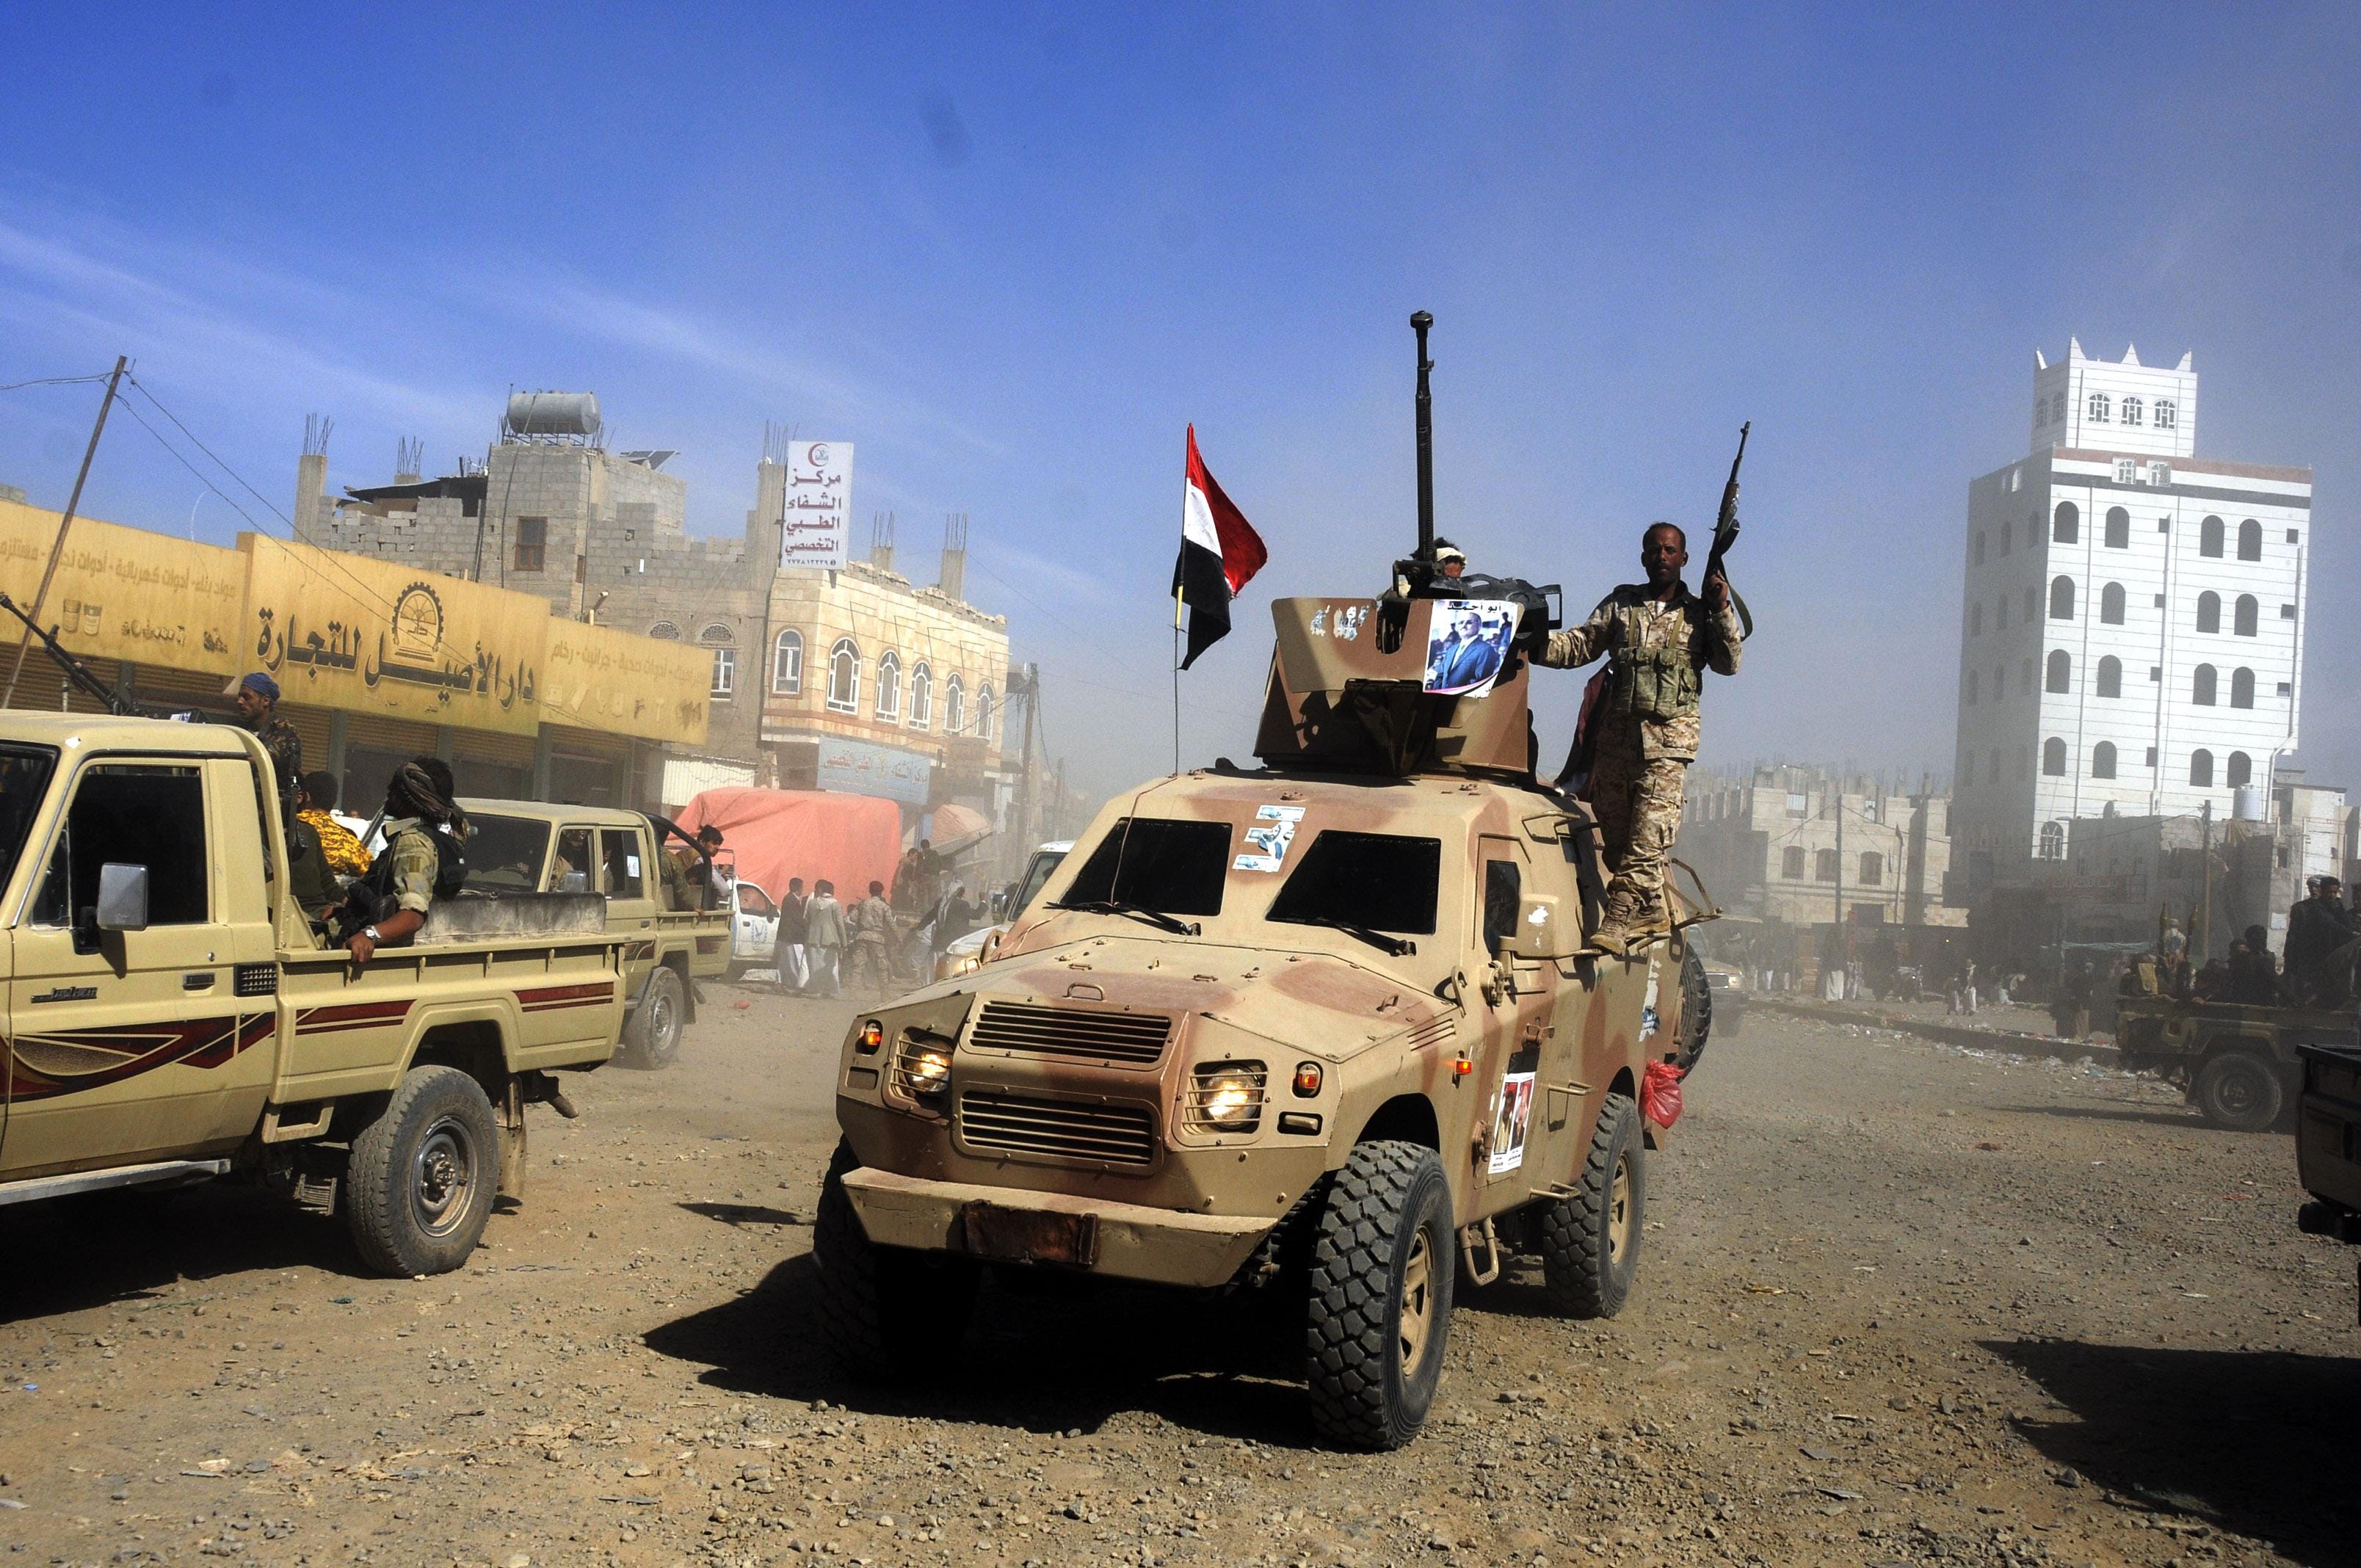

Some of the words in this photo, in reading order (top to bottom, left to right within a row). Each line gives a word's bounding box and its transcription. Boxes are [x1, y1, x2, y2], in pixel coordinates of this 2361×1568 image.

[790, 468, 841, 488] مركز
[786, 492, 842, 510] الشفاء
[786, 515, 840, 537] الطبي
[785, 537, 839, 556] التخصصي
[213, 578, 236, 602] مواد
[256, 606, 361, 680] للتجارة
[550, 640, 574, 664] رخام
[364, 631, 501, 703] الأصيل
[581, 645, 611, 671] جرانيت
[498, 658, 534, 710] دار
